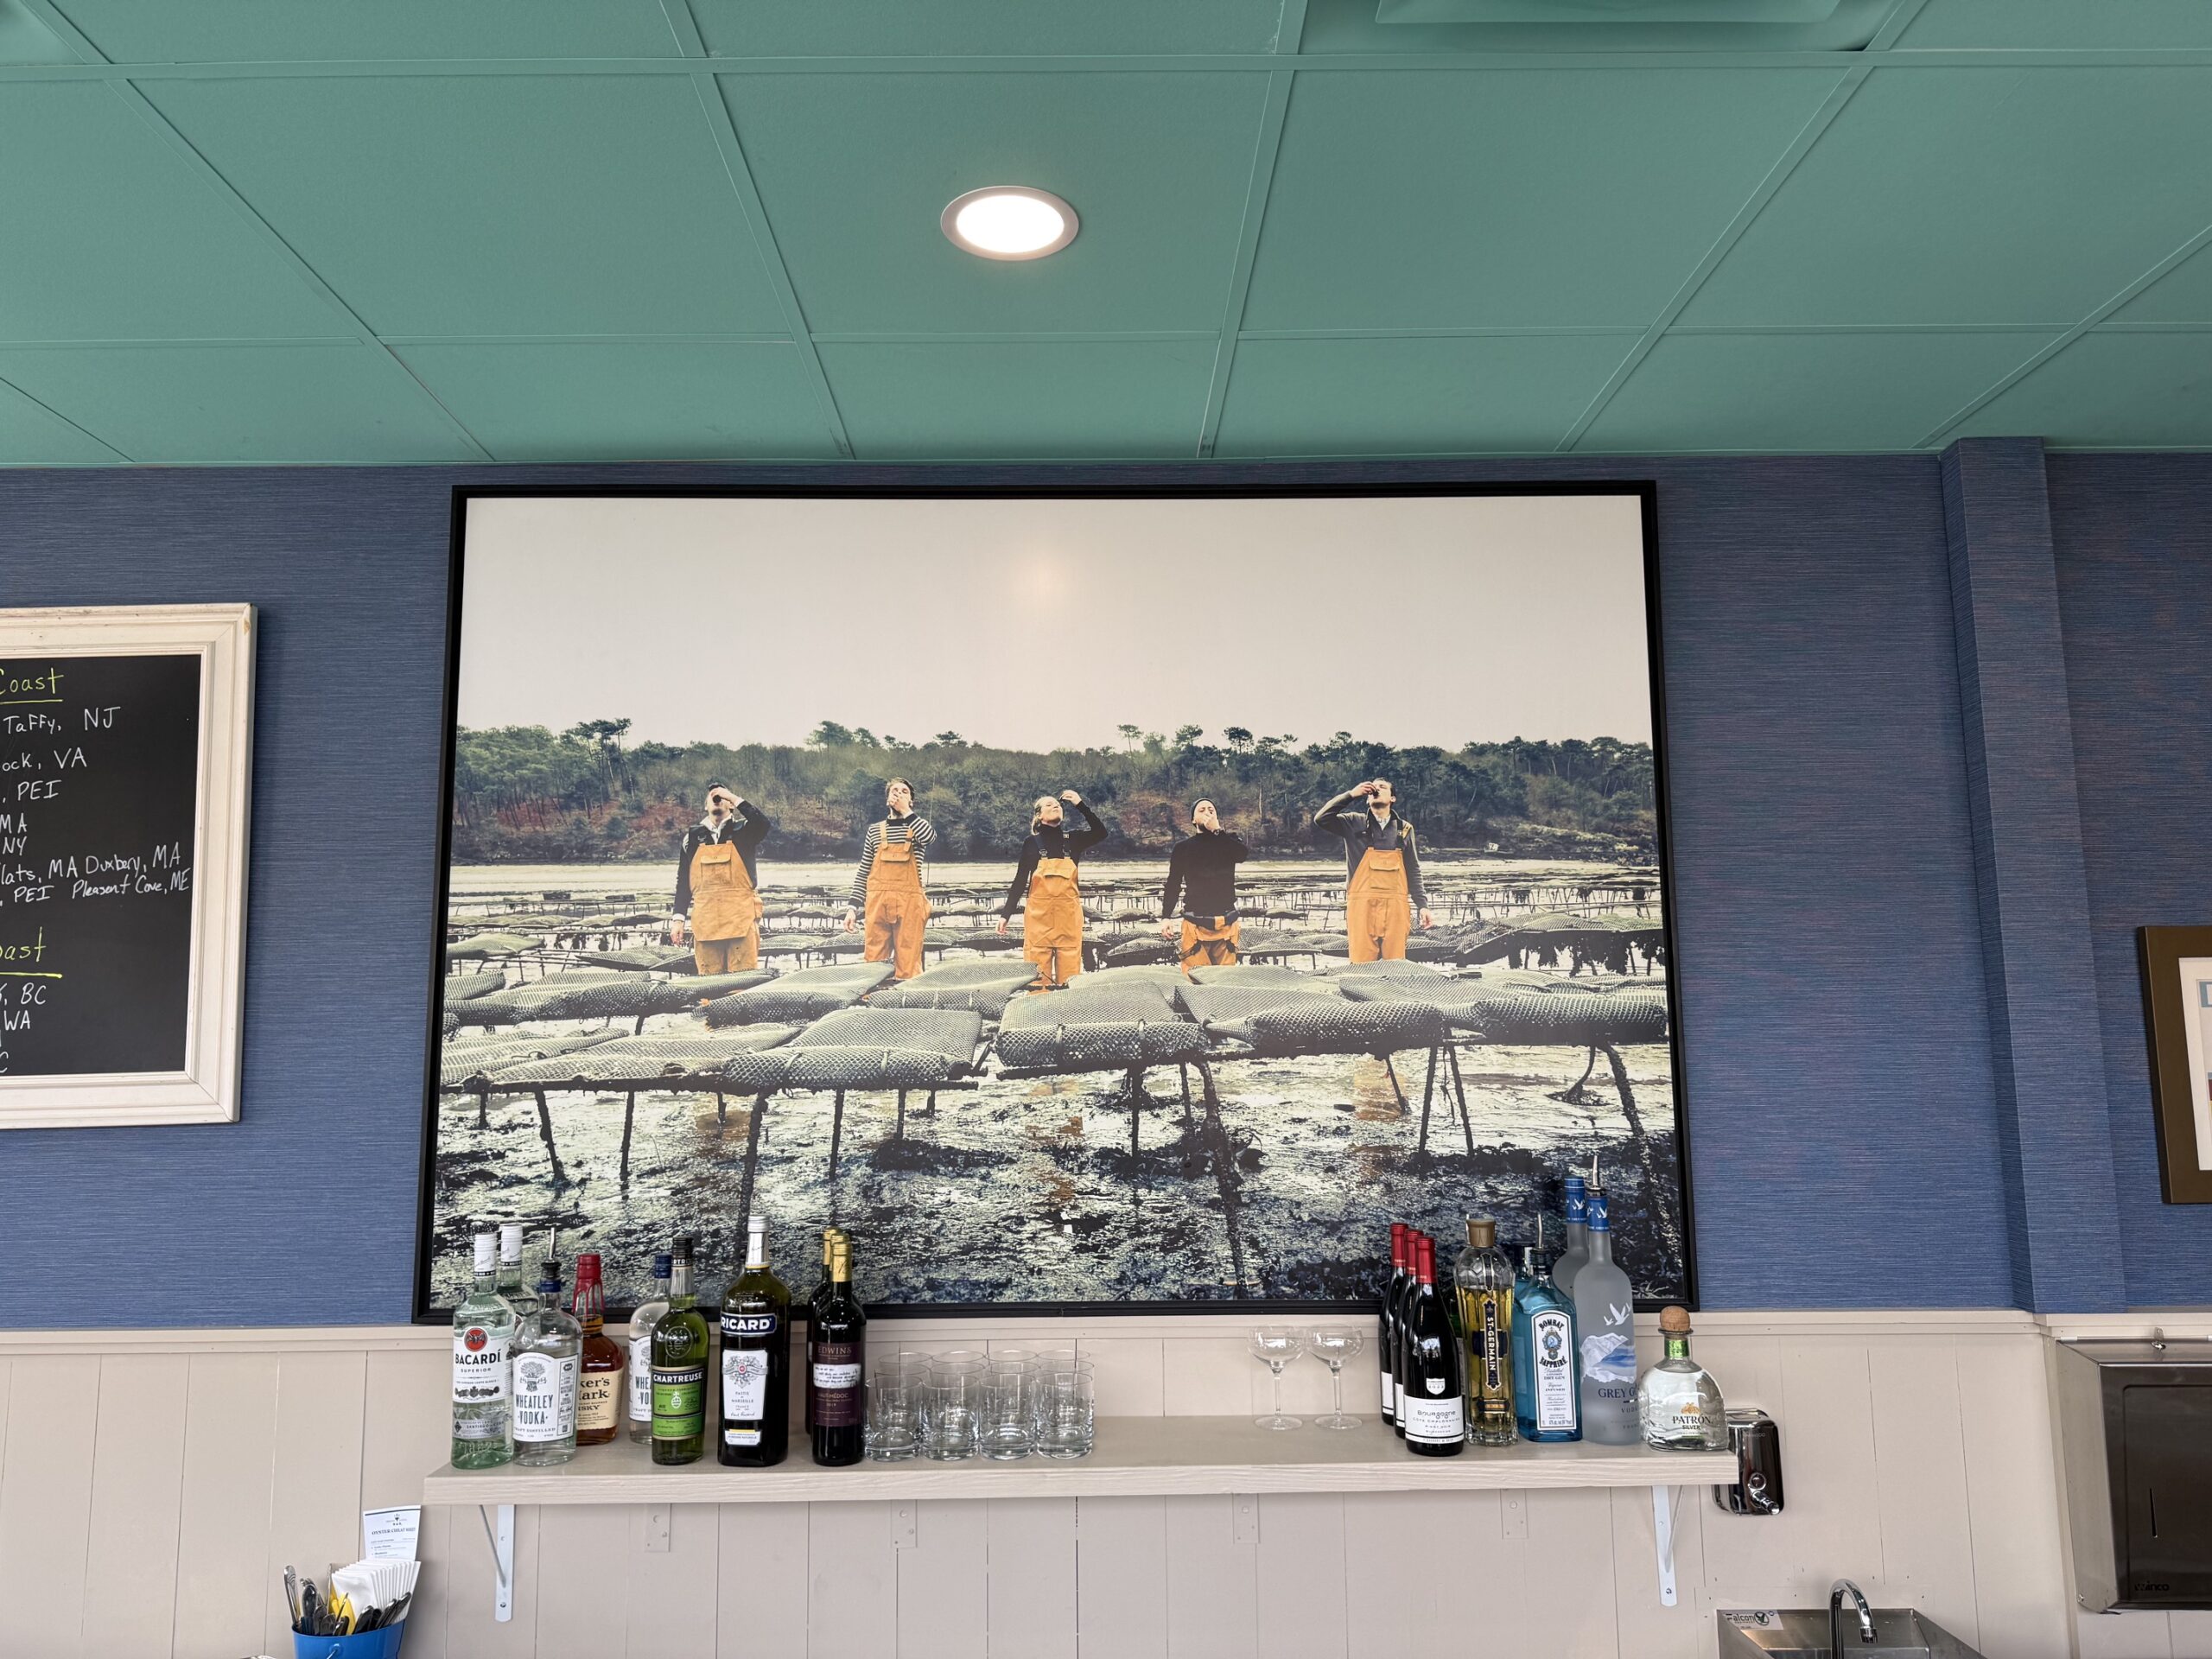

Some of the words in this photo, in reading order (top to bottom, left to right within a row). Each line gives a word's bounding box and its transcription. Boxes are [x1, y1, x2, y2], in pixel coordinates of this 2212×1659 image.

[84, 706, 122, 731] NJ
[54, 747, 88, 769] VA
[17, 779, 62, 801] PEI
[3, 836, 28, 856] NY
[0, 862, 42, 885] lats,
[48, 855, 79, 880] MA
[152, 842, 181, 869] MA
[14, 885, 55, 903] PEI
[170, 867, 192, 892] ME
[20, 982, 47, 1005] BC
[3, 1009, 31, 1031] WA
[721, 1316, 771, 1331] RICARD
[1538, 1319, 1565, 1331] BOMBAY
[817, 1346, 852, 1355] EDWINS
[1486, 1317, 1497, 1371] ST-GERMAIN
[454, 1349, 501, 1365] BACARDÍ
[1539, 1355, 1567, 1368] SAPPHIRE
[652, 1371, 703, 1383] CHARTREUSE
[579, 1389, 609, 1400] ark
[1598, 1388, 1625, 1398] GREY
[515, 1394, 553, 1409] WHEATLEY
[519, 1410, 545, 1425] VODKA
[1417, 1409, 1456, 1420] Bourgogne
[1725, 1612, 1756, 1622] Falcon
